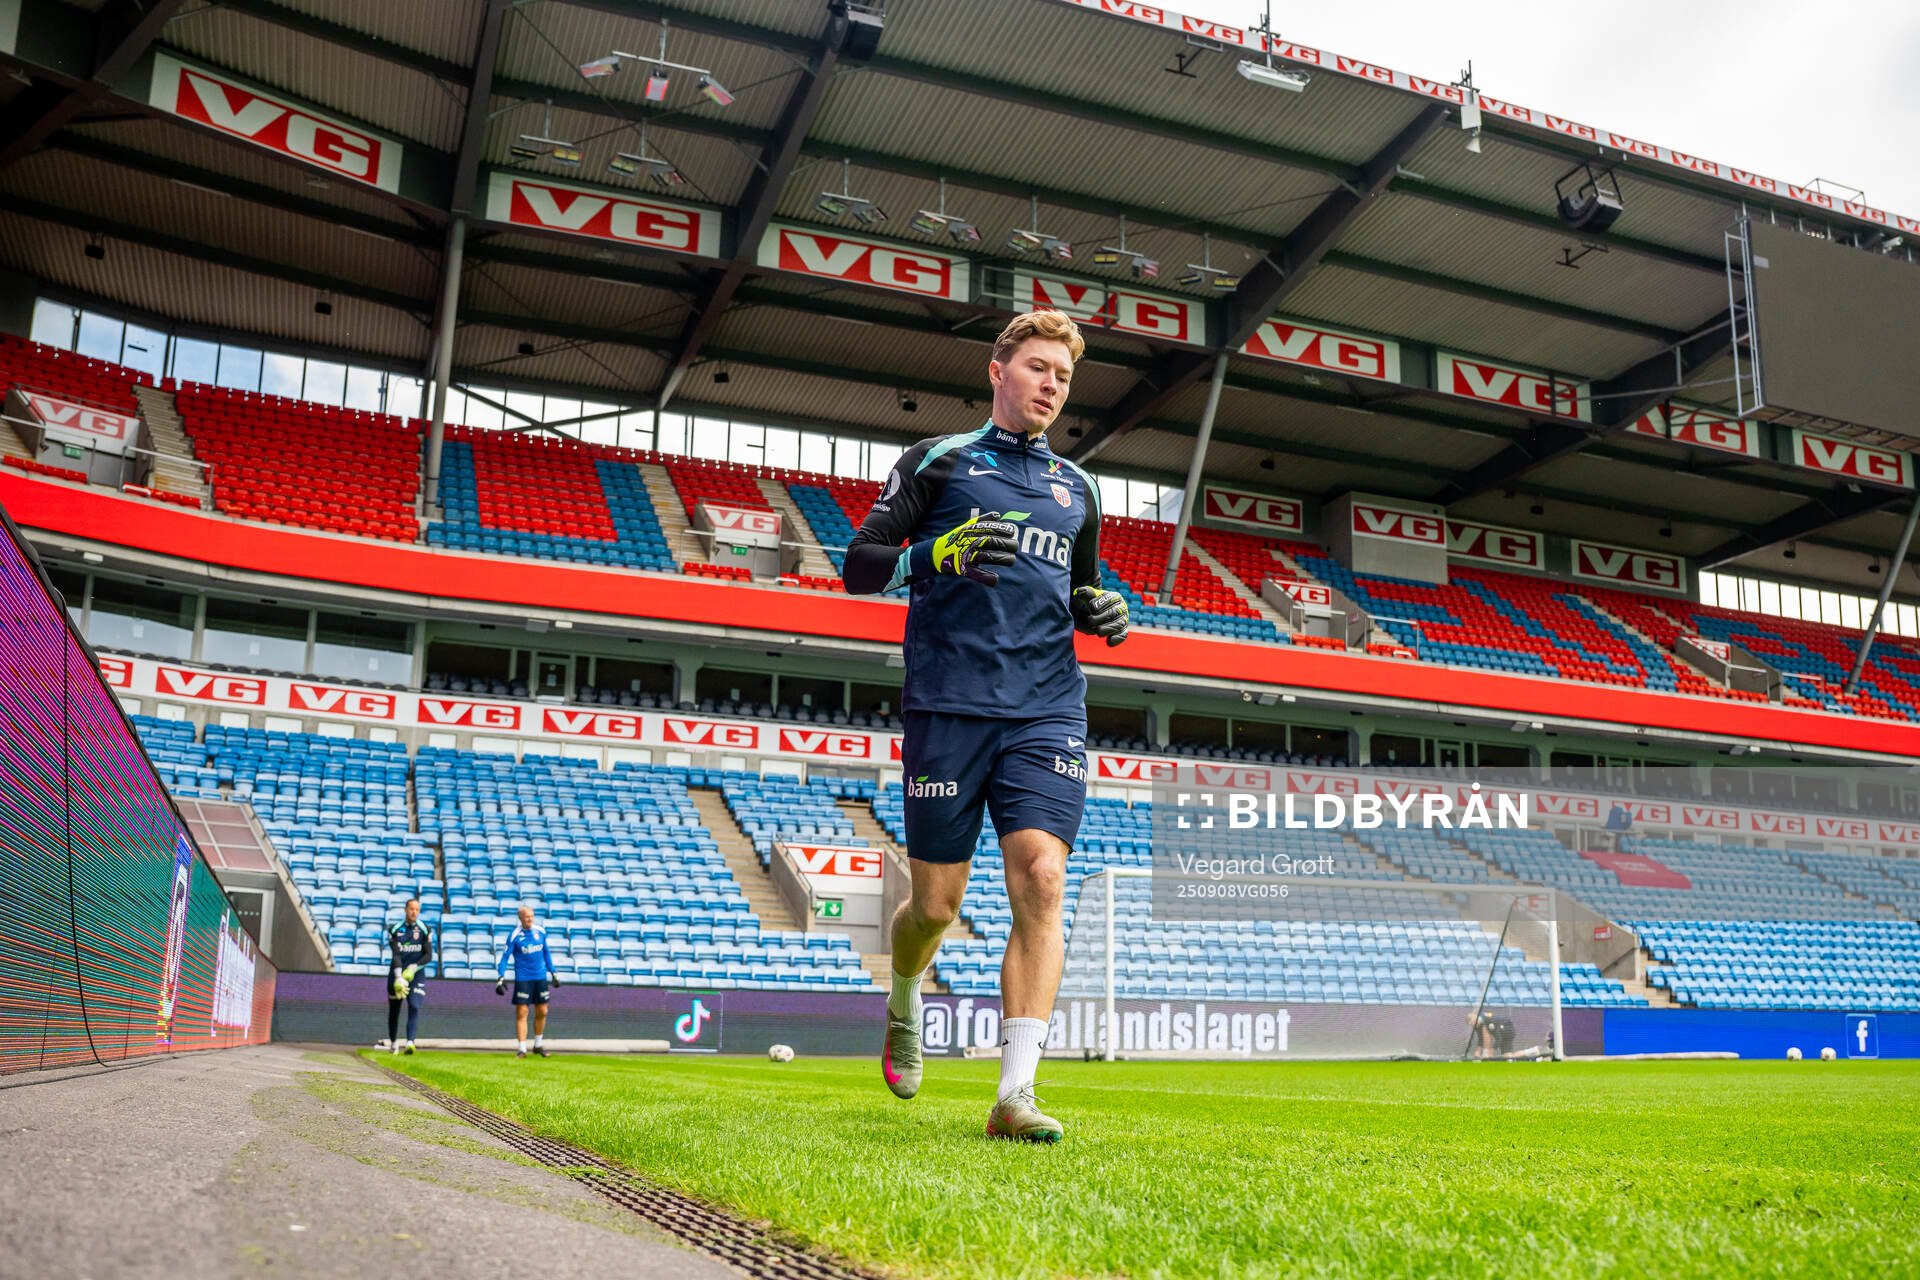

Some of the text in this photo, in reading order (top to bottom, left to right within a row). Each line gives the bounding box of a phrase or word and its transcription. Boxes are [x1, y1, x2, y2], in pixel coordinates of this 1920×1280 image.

[186, 73, 371, 179] VG
[1104, 0, 1920, 235] VG VG VG VG VG VG VG VG VG VG VG VG V
[515, 182, 691, 250] VG
[783, 231, 944, 296] VG
[1036, 276, 1181, 338] VG
[1254, 320, 1381, 377] VG
[1457, 361, 1573, 416] VG
[35, 399, 120, 436] VG
[996, 430, 1018, 444] bama
[1804, 438, 1900, 482] VG
[707, 508, 776, 533] VG
[971, 520, 1014, 532] reusch
[1210, 492, 1295, 526] VG
[1357, 508, 1440, 541] VG
[1447, 525, 1532, 564] VG
[1580, 546, 1675, 586] VG
[162, 669, 260, 702] VG
[294, 685, 391, 717] VG
[422, 700, 516, 729] VG
[548, 710, 637, 738] VG
[669, 720, 753, 748] VG
[783, 730, 866, 757] VG
[1102, 757, 1173, 782] VG
[1197, 766, 1266, 790] VG
[1289, 774, 1353, 797] VG
[1539, 795, 1595, 816] VG
[1684, 808, 1735, 829] VG
[1753, 814, 1801, 834] VG
[1818, 820, 1865, 839] VG
[908, 776, 958, 798] bama
[788, 847, 881, 877] VG
[922, 998, 1290, 1056] @foallandslaget
